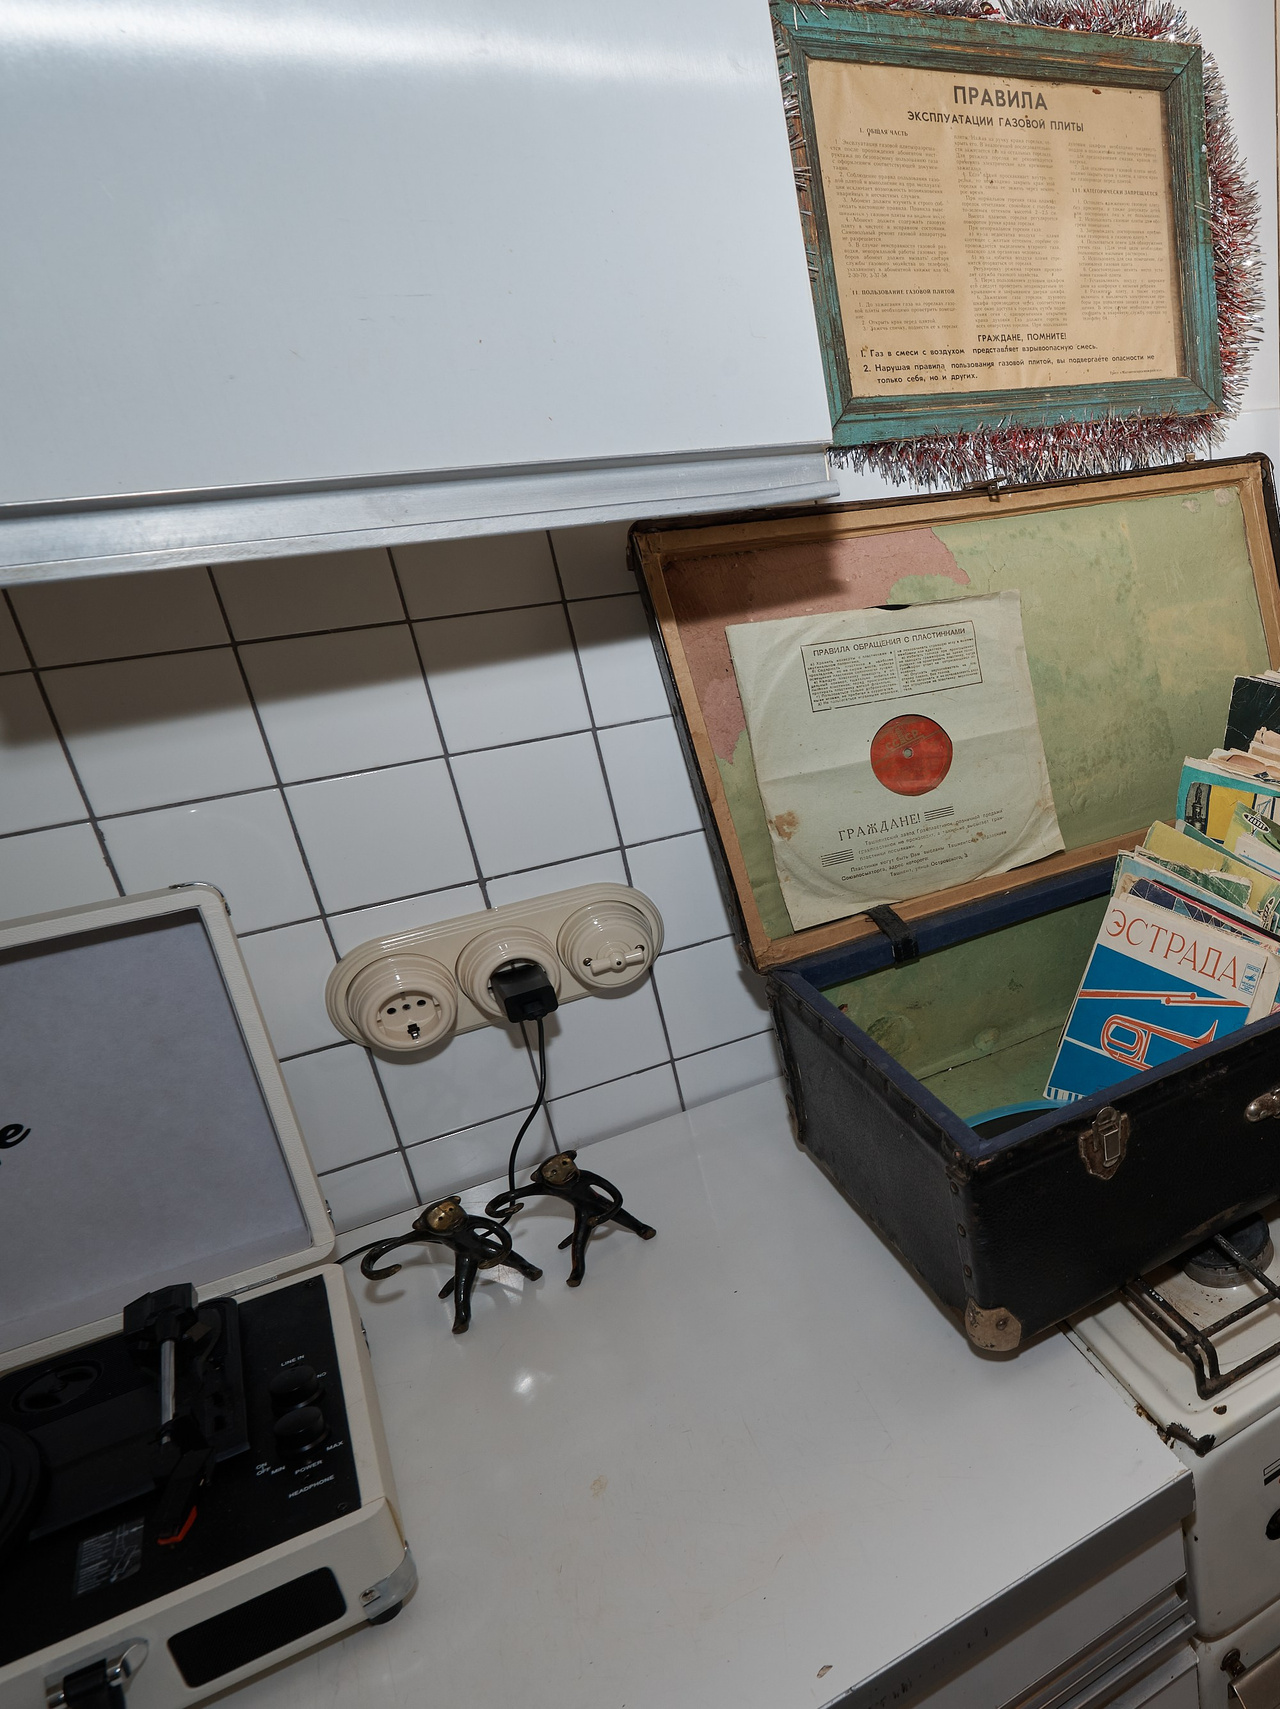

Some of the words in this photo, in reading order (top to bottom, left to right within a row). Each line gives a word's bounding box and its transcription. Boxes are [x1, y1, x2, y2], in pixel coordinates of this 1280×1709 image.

[953, 84, 1048, 111] ПРАВИЛА
[906, 110, 994, 127] ЭКСПЛУАТАЦИИ
[998, 117, 1045, 129] ГАЗОВОЙ
[1049, 120, 1084, 132] ПЛИТЫ
[866, 127, 888, 135] ОБЩАЯ
[889, 129, 909, 137] ЧАСТЬ
[1082, 187, 1123, 195] КАТЕГОРИЧЕСКИ
[977, 333, 1023, 342] ГРАЖДАНЕ,
[1026, 332, 1067, 341] ПОМНИТЕ!
[869, 348, 884, 358] Газ
[895, 349, 919, 357] смеси
[929, 348, 965, 356] воздухом
[972, 344, 1019, 354] представляет
[1021, 344, 1074, 352] взрывоопасную
[862, 363, 871, 372] 2.
[874, 363, 911, 373] Нарушая
[913, 363, 946, 371] правила
[950, 361, 995, 369] пользования
[997, 358, 1025, 367] газовой
[1027, 357, 1054, 365] плитой,
[1068, 354, 1109, 364] подвергаете
[906, 373, 926, 383] себя,
[950, 373, 978, 381] других.
[812, 645, 851, 657] ПРАВИЛА
[852, 637, 902, 651] ОБРАЩЕНИЯ
[903, 635, 910, 643] С
[911, 627, 966, 642] ПЛАСТИНКАМИ
[837, 812, 921, 841] ГРАЖДАНЕ!
[900, 830, 915, 838] завод
[850, 862, 878, 872] Пластинки
[888, 862, 904, 870] адрес
[1106, 909, 1237, 988] ЭСТРАДА
[281, 1357, 296, 1367] LINE
[326, 1440, 344, 1451] MAX
[255, 1461, 268, 1470] ON
[270, 1465, 286, 1475] MIN
[294, 1459, 323, 1475] POWER
[256, 1466, 271, 1476] OFF
[288, 1474, 335, 1499] HEADPHONE
